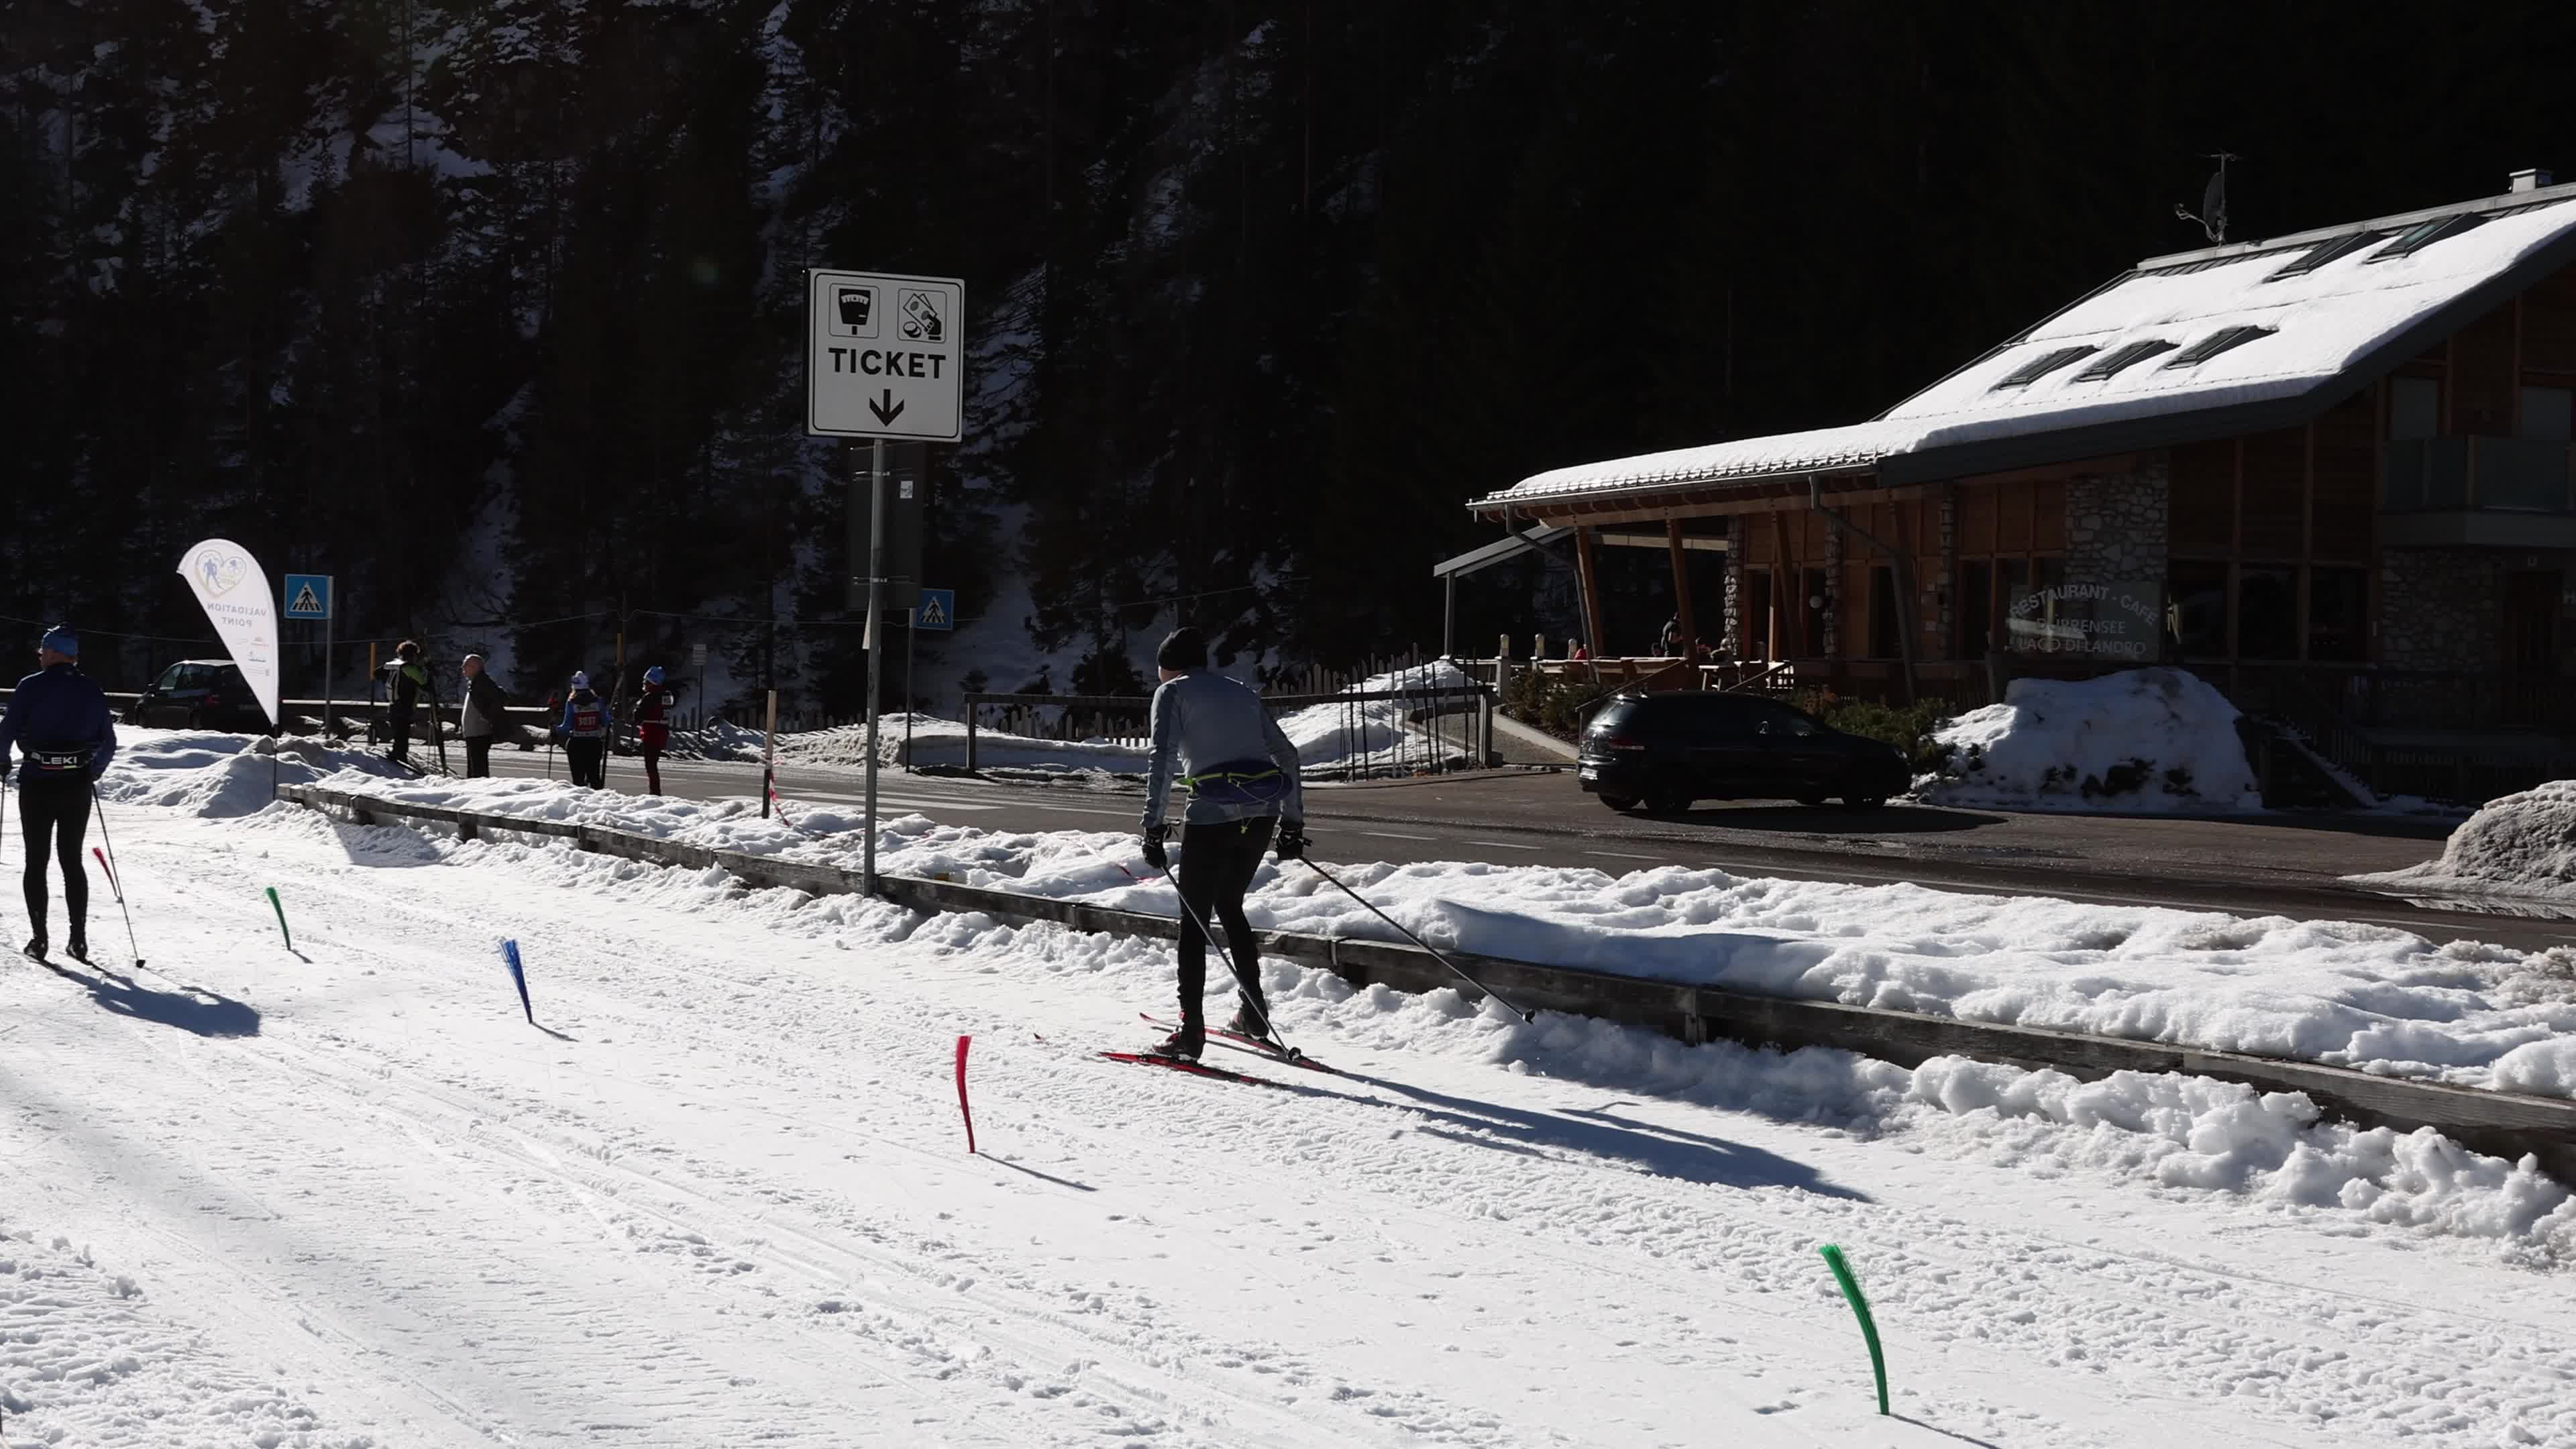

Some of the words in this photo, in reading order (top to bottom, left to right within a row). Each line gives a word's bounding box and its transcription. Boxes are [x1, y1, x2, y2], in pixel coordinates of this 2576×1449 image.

[828, 347, 946, 378] TICKET
[2009, 584, 2109, 619] RESTAURANT
[41, 756, 77, 764] LEKI
